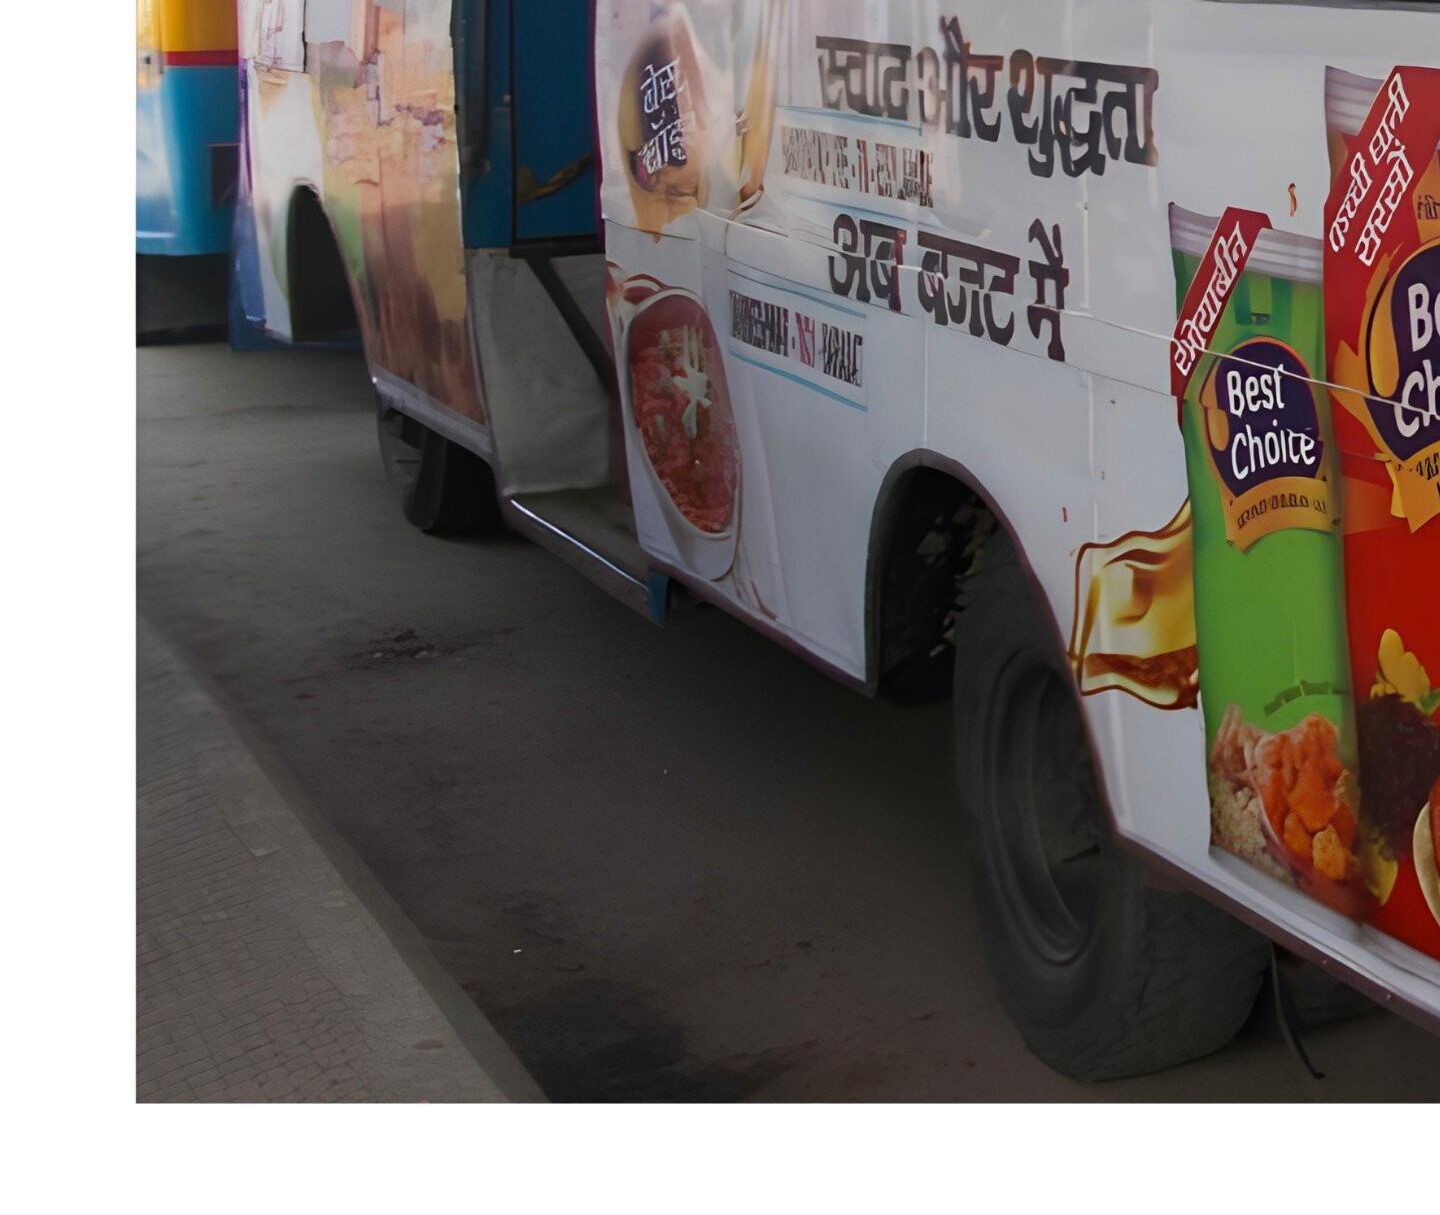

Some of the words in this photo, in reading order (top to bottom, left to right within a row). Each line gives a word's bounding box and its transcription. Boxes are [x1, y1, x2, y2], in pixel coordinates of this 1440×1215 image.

[816, 35, 911, 121] स्वाद
[912, 16, 1003, 142] और
[1009, 49, 1159, 178] शुद्धता
[1354, 137, 1414, 267] सरसों
[829, 213, 907, 314] अब
[917, 230, 1021, 347] बजट
[1028, 218, 1069, 362] में
[1227, 364, 1284, 418] Best
[1231, 418, 1316, 481] Choice
